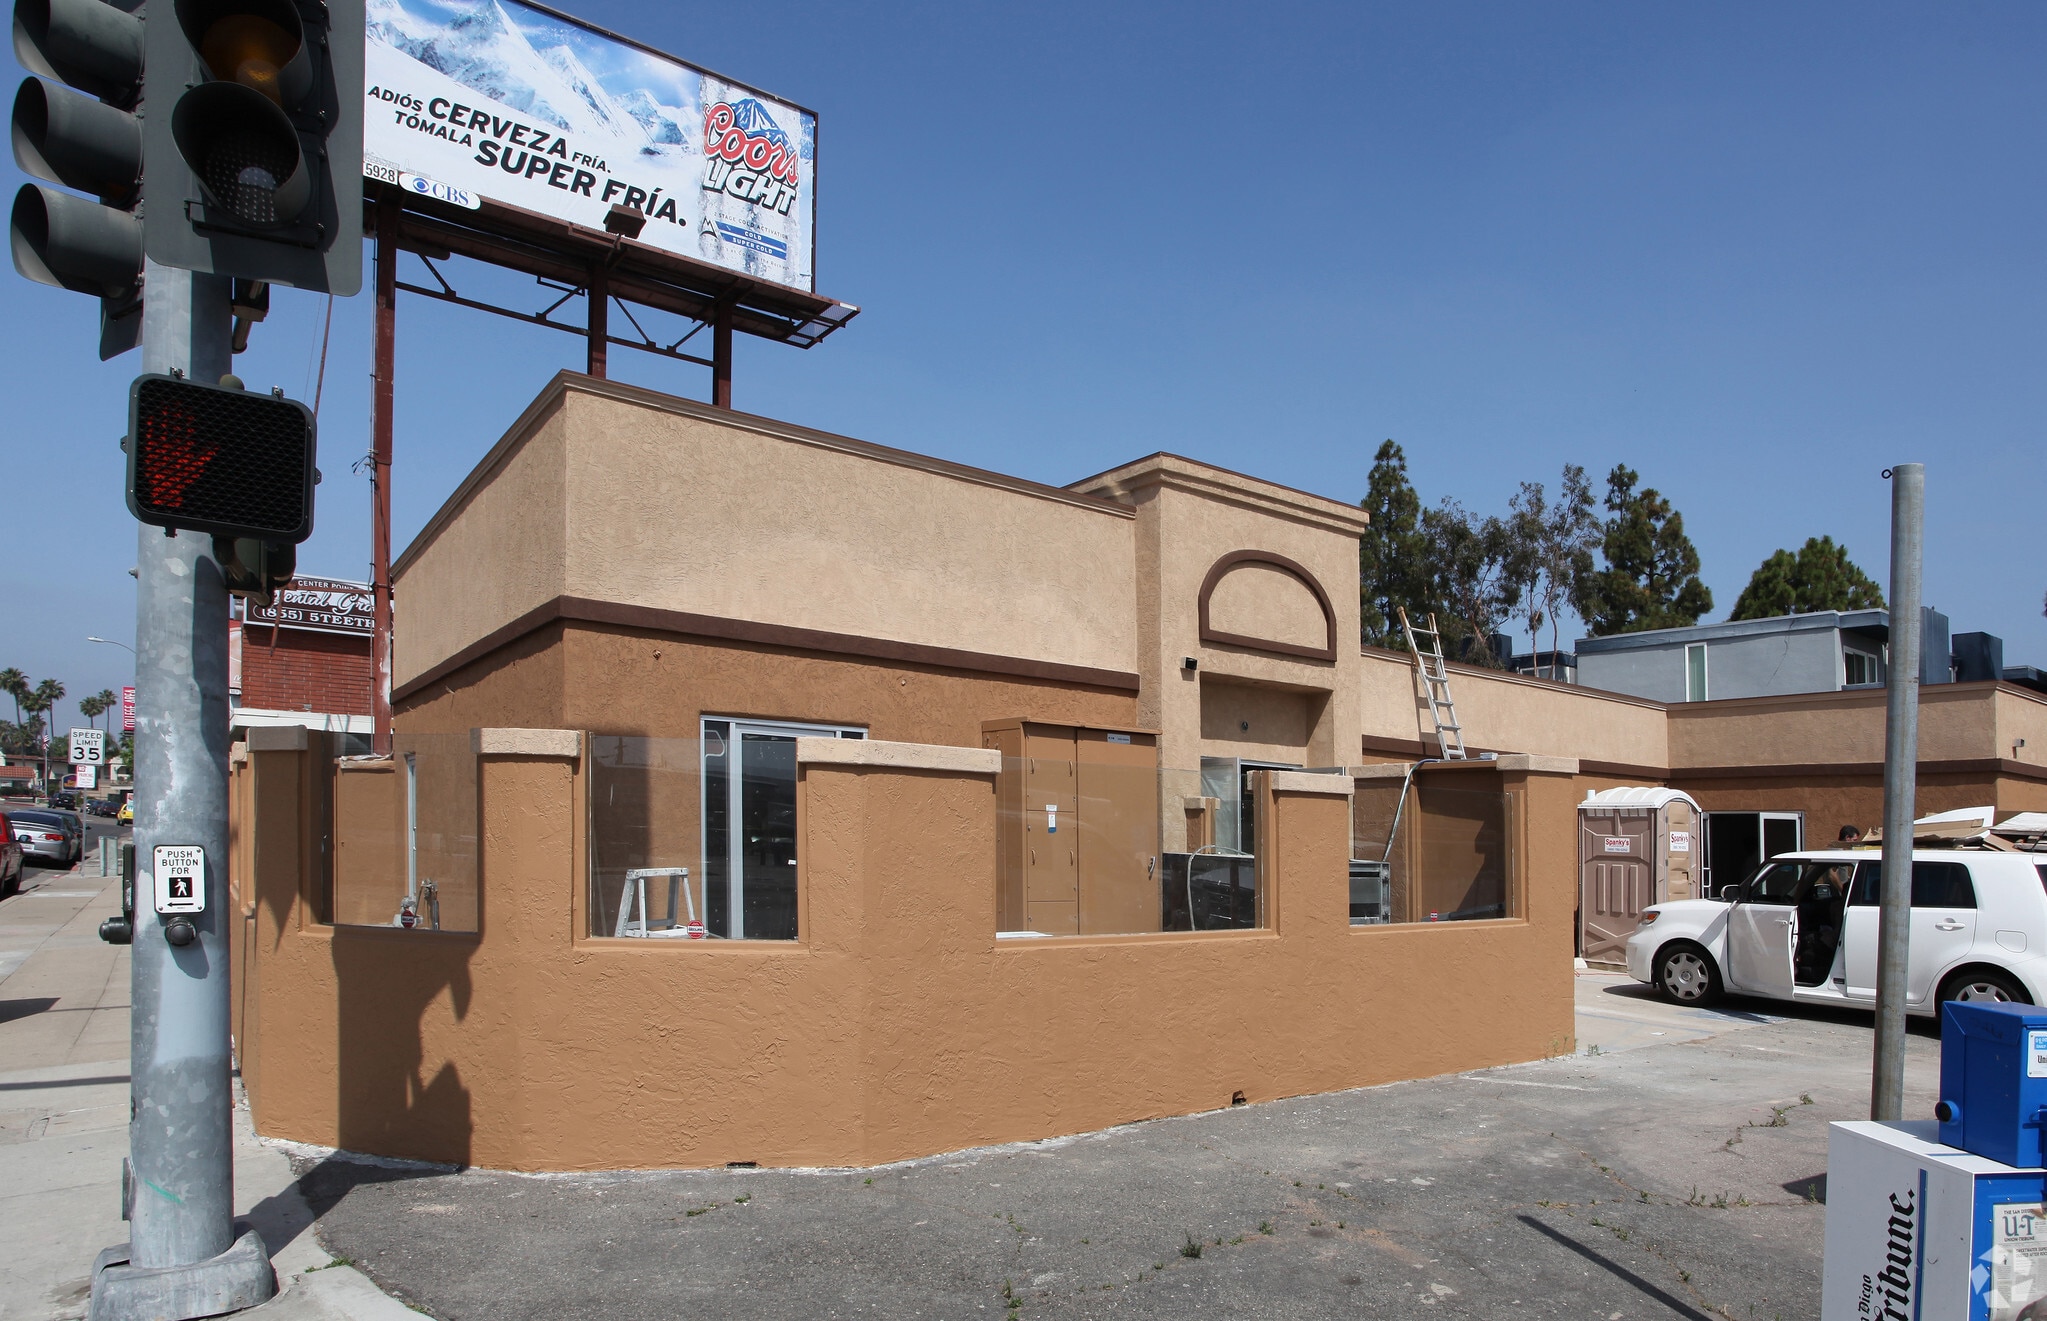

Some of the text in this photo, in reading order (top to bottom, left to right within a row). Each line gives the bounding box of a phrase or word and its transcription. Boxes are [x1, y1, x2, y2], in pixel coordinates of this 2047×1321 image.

[368, 85, 612, 174] ADIÓS CERVEZA FRÍA.
[703, 101, 799, 187] Coors
[365, 163, 396, 182] 5928
[395, 110, 472, 147] TÓMALA
[474, 139, 597, 197] SUPER
[601, 178, 687, 227] FRÍA.
[432, 183, 469, 206] CBS
[702, 159, 797, 216] LIGHT
[744, 231, 762, 241] COLD
[732, 237, 773, 254] SUPER COLD
[298, 580, 329, 588] CENTER
[261, 607, 303, 621] (855)
[124, 705, 135, 728] COLLEGE
[73, 731, 102, 739] SPEED
[73, 747, 100, 761] 35
[1605, 838, 1630, 847] Spanky's
[167, 850, 193, 858] PUSH
[171, 867, 190, 875] FOR
[1858, 1274, 1873, 1314] Diego
